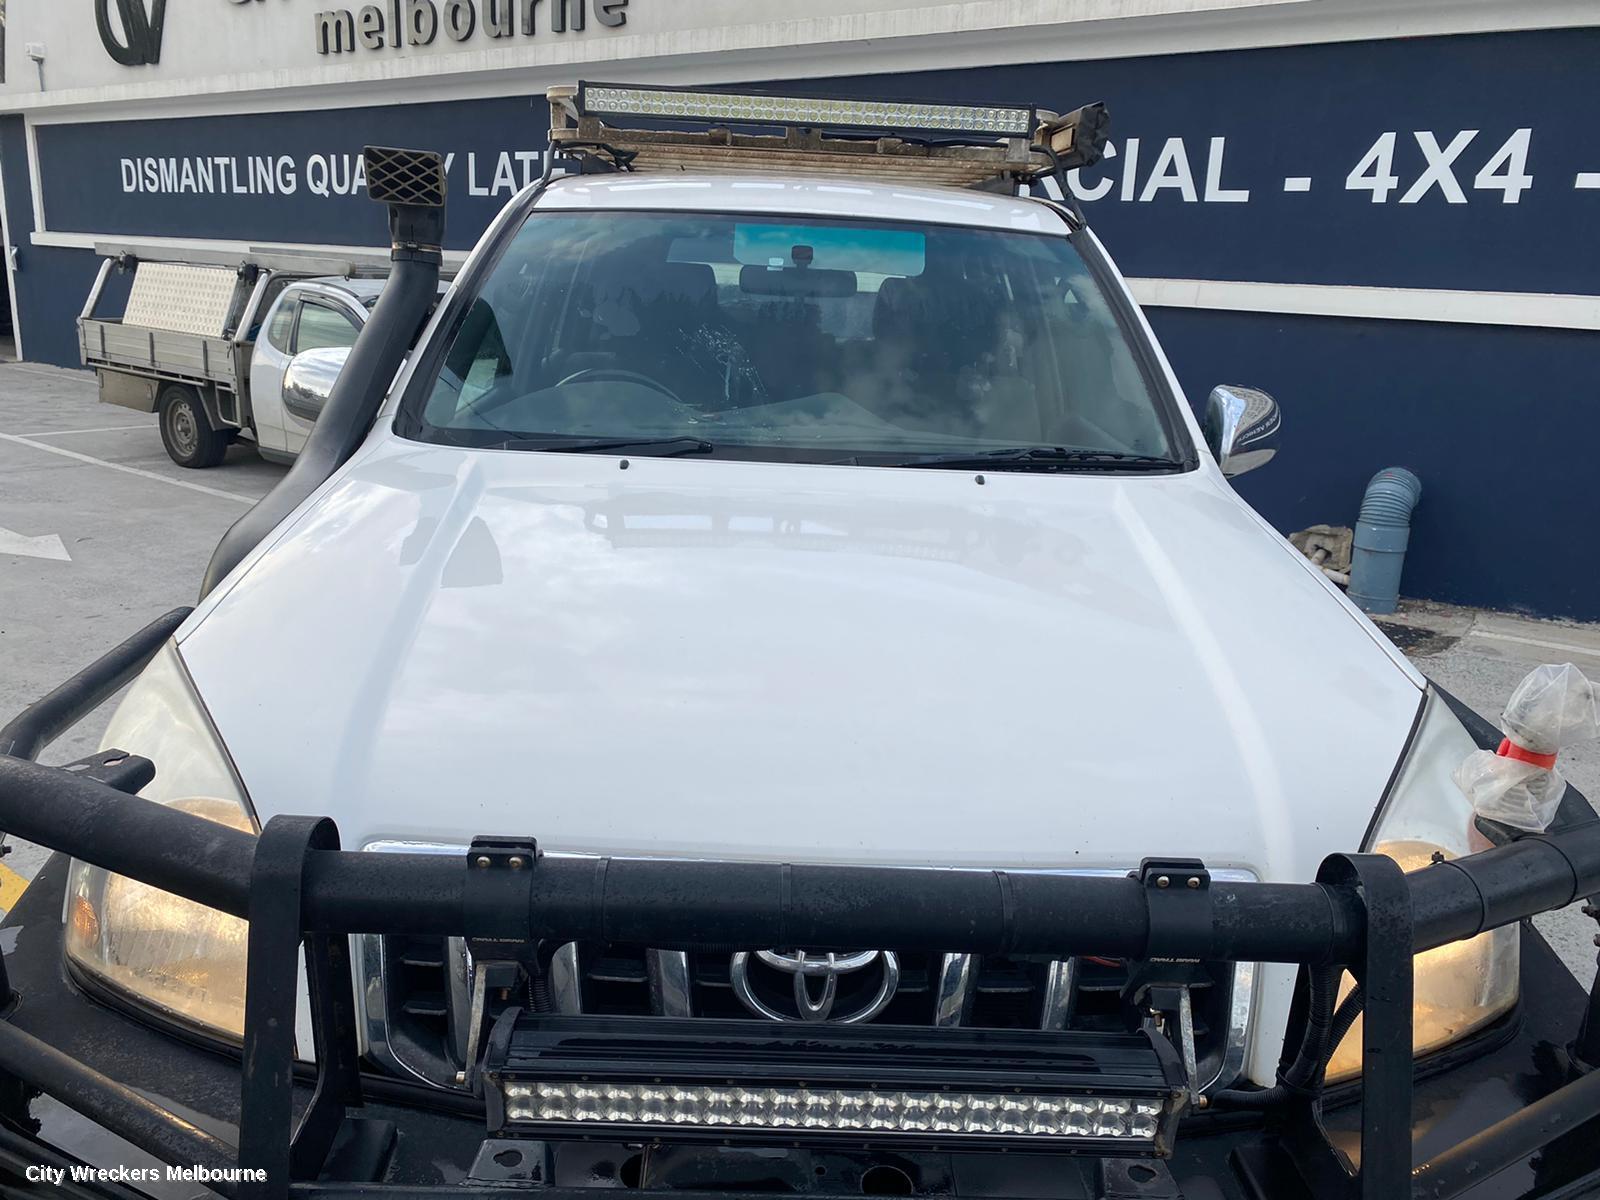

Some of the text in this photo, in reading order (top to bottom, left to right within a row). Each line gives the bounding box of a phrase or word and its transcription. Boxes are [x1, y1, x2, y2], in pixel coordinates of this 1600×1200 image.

[314, 0, 629, 55] melbourne
[120, 154, 297, 195] DISMANTLING
[1345, 127, 1533, 204] 4X4
